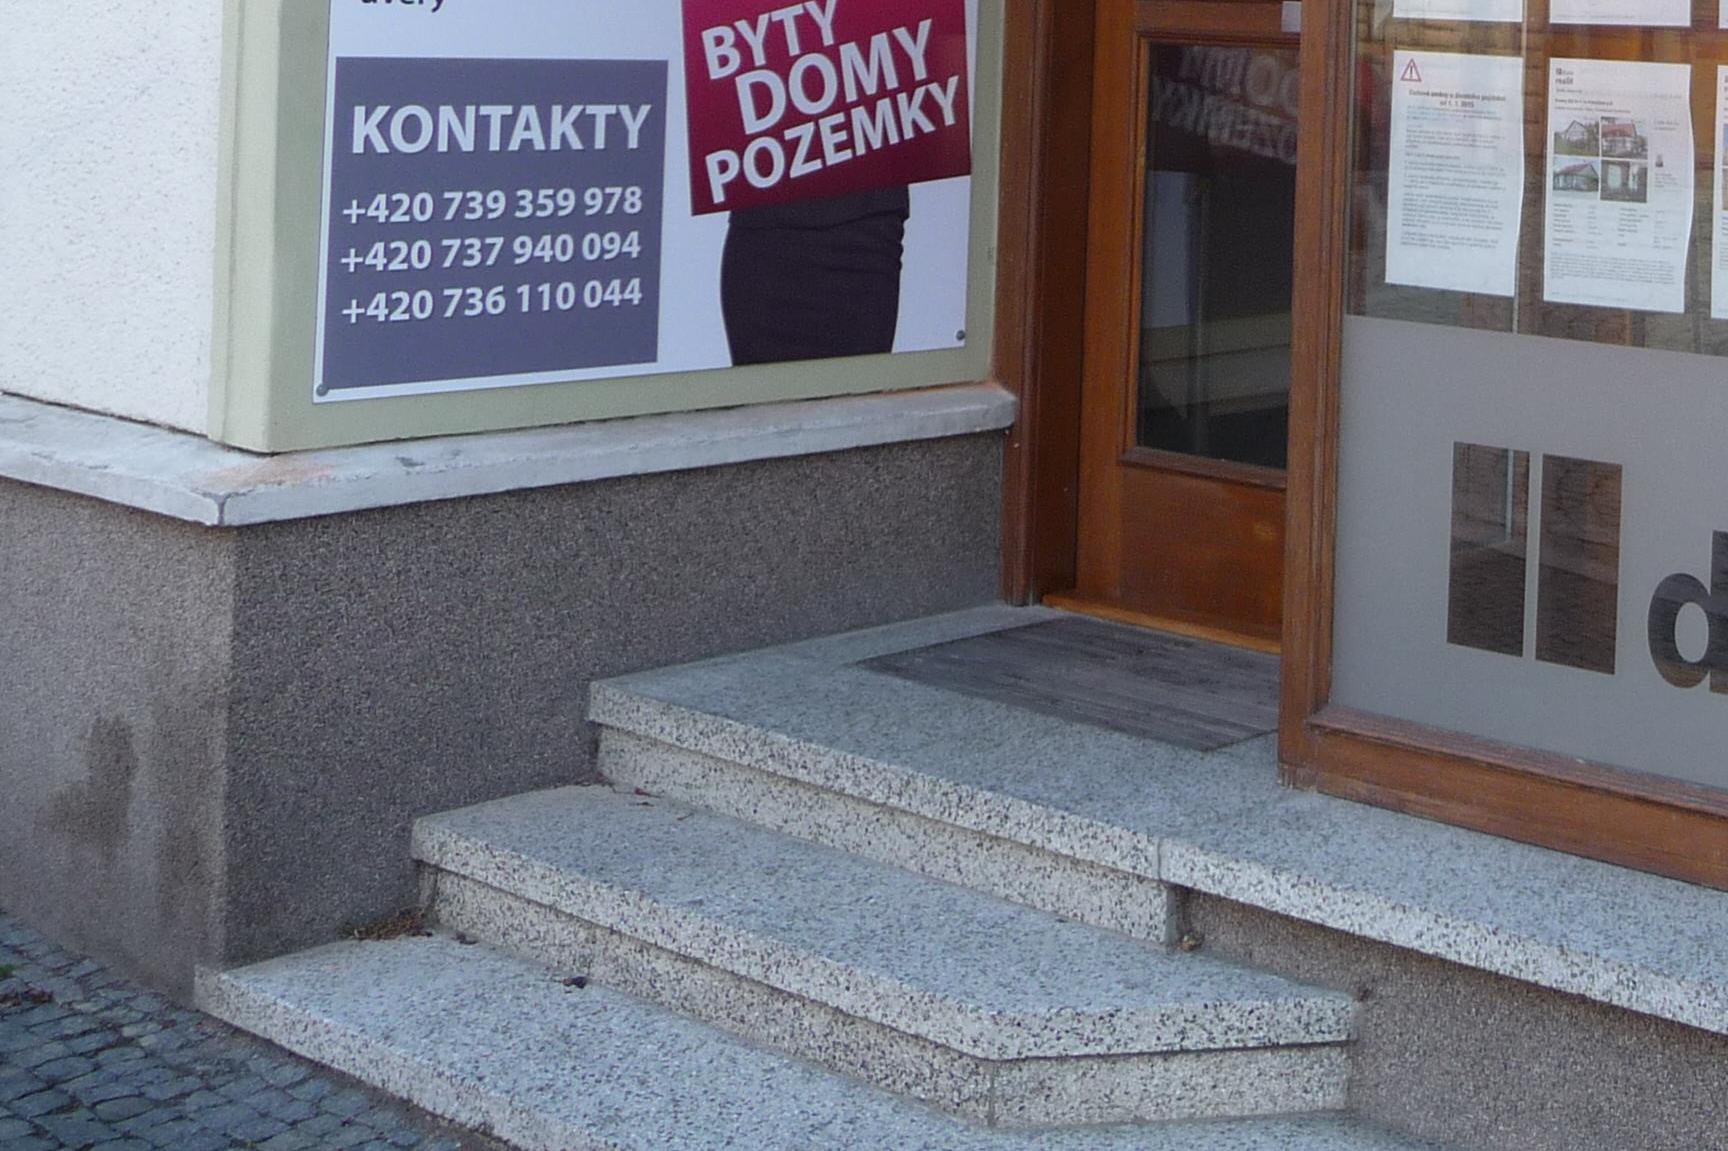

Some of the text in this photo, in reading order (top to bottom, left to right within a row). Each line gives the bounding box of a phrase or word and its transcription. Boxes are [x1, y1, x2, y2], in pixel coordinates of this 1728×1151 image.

[734, 18, 932, 136] DOMY
[350, 103, 652, 155] KONTAKTY
[704, 75, 960, 205] POZEMKY
[342, 185, 642, 226] +420 739 359 978
[340, 230, 640, 273] +420 737 940 094
[341, 277, 642, 324] +420 736 110 044
